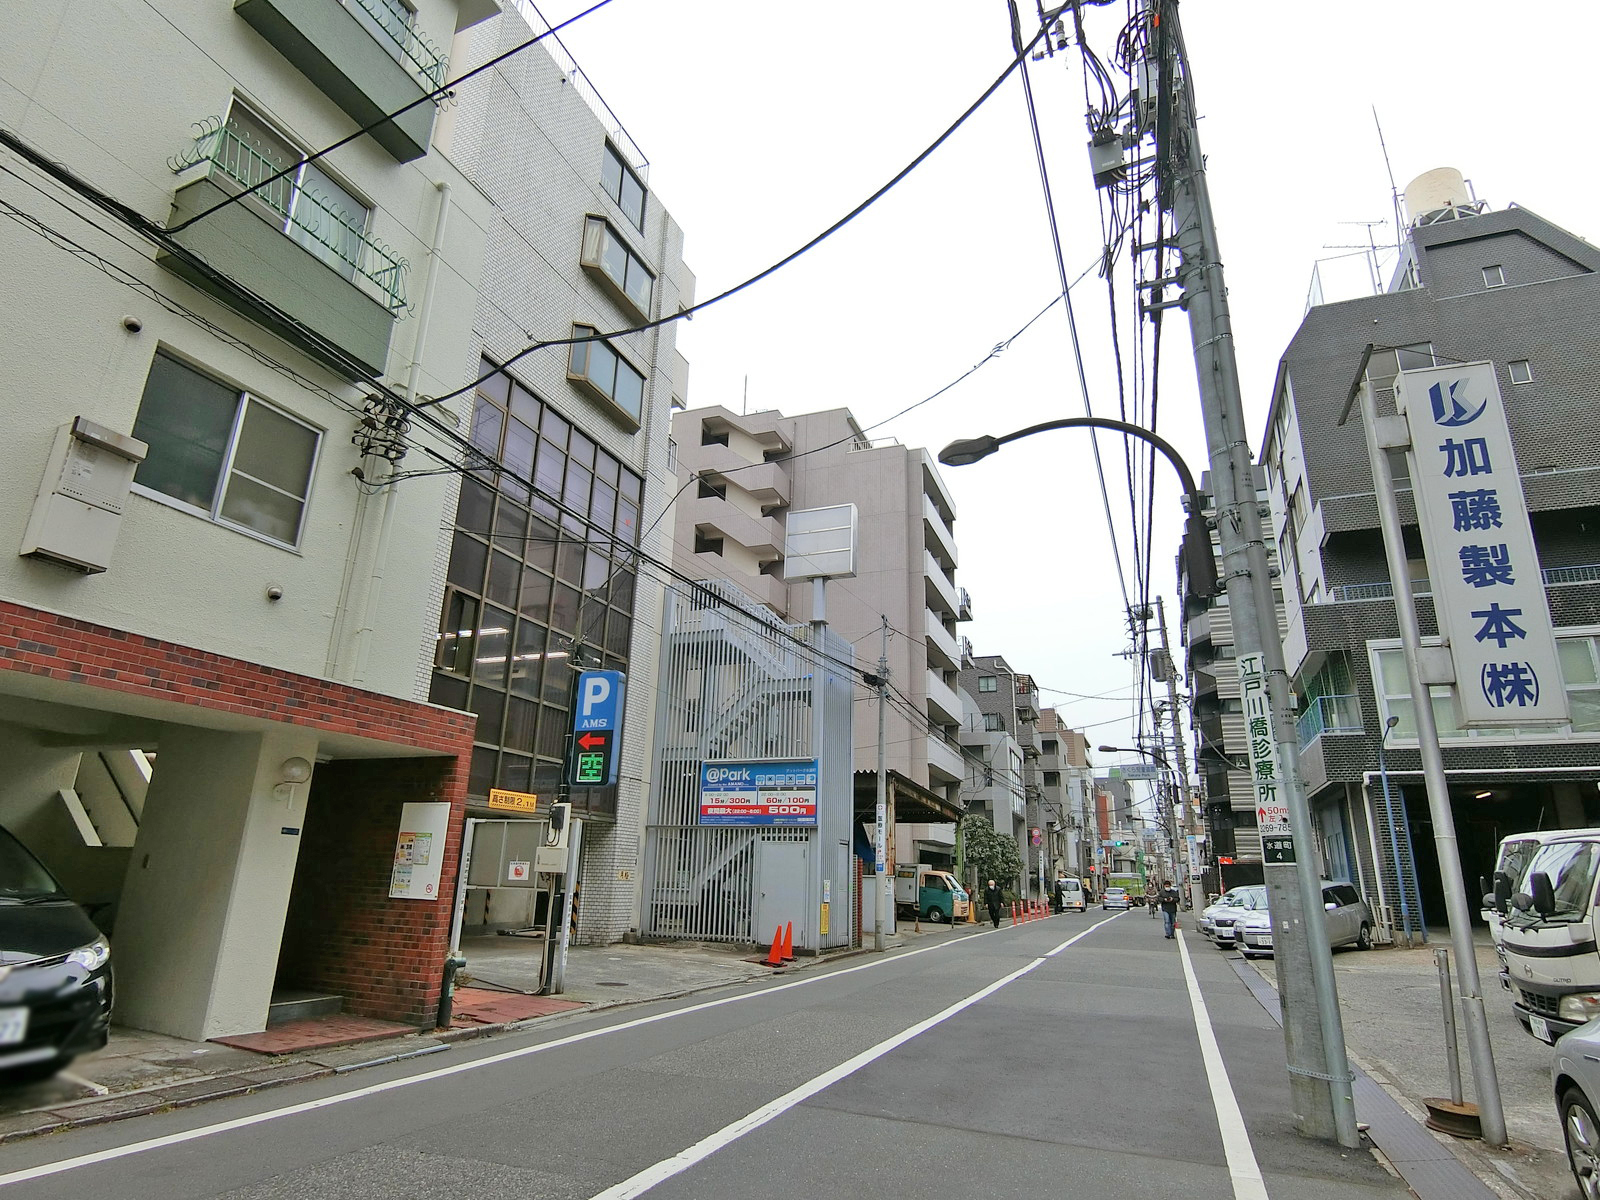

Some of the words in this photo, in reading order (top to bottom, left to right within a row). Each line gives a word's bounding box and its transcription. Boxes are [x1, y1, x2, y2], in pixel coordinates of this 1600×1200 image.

[582, 677, 610, 716] P
[581, 718, 608, 728] AMS
[1240, 656, 1276, 803] 江戸川橋診療所
[579, 753, 603, 780] 空
[706, 767, 751, 783] @Park
[768, 806, 807, 814] 500円
[1266, 841, 1292, 850] 水道町
[1276, 852, 1283, 860] 4
